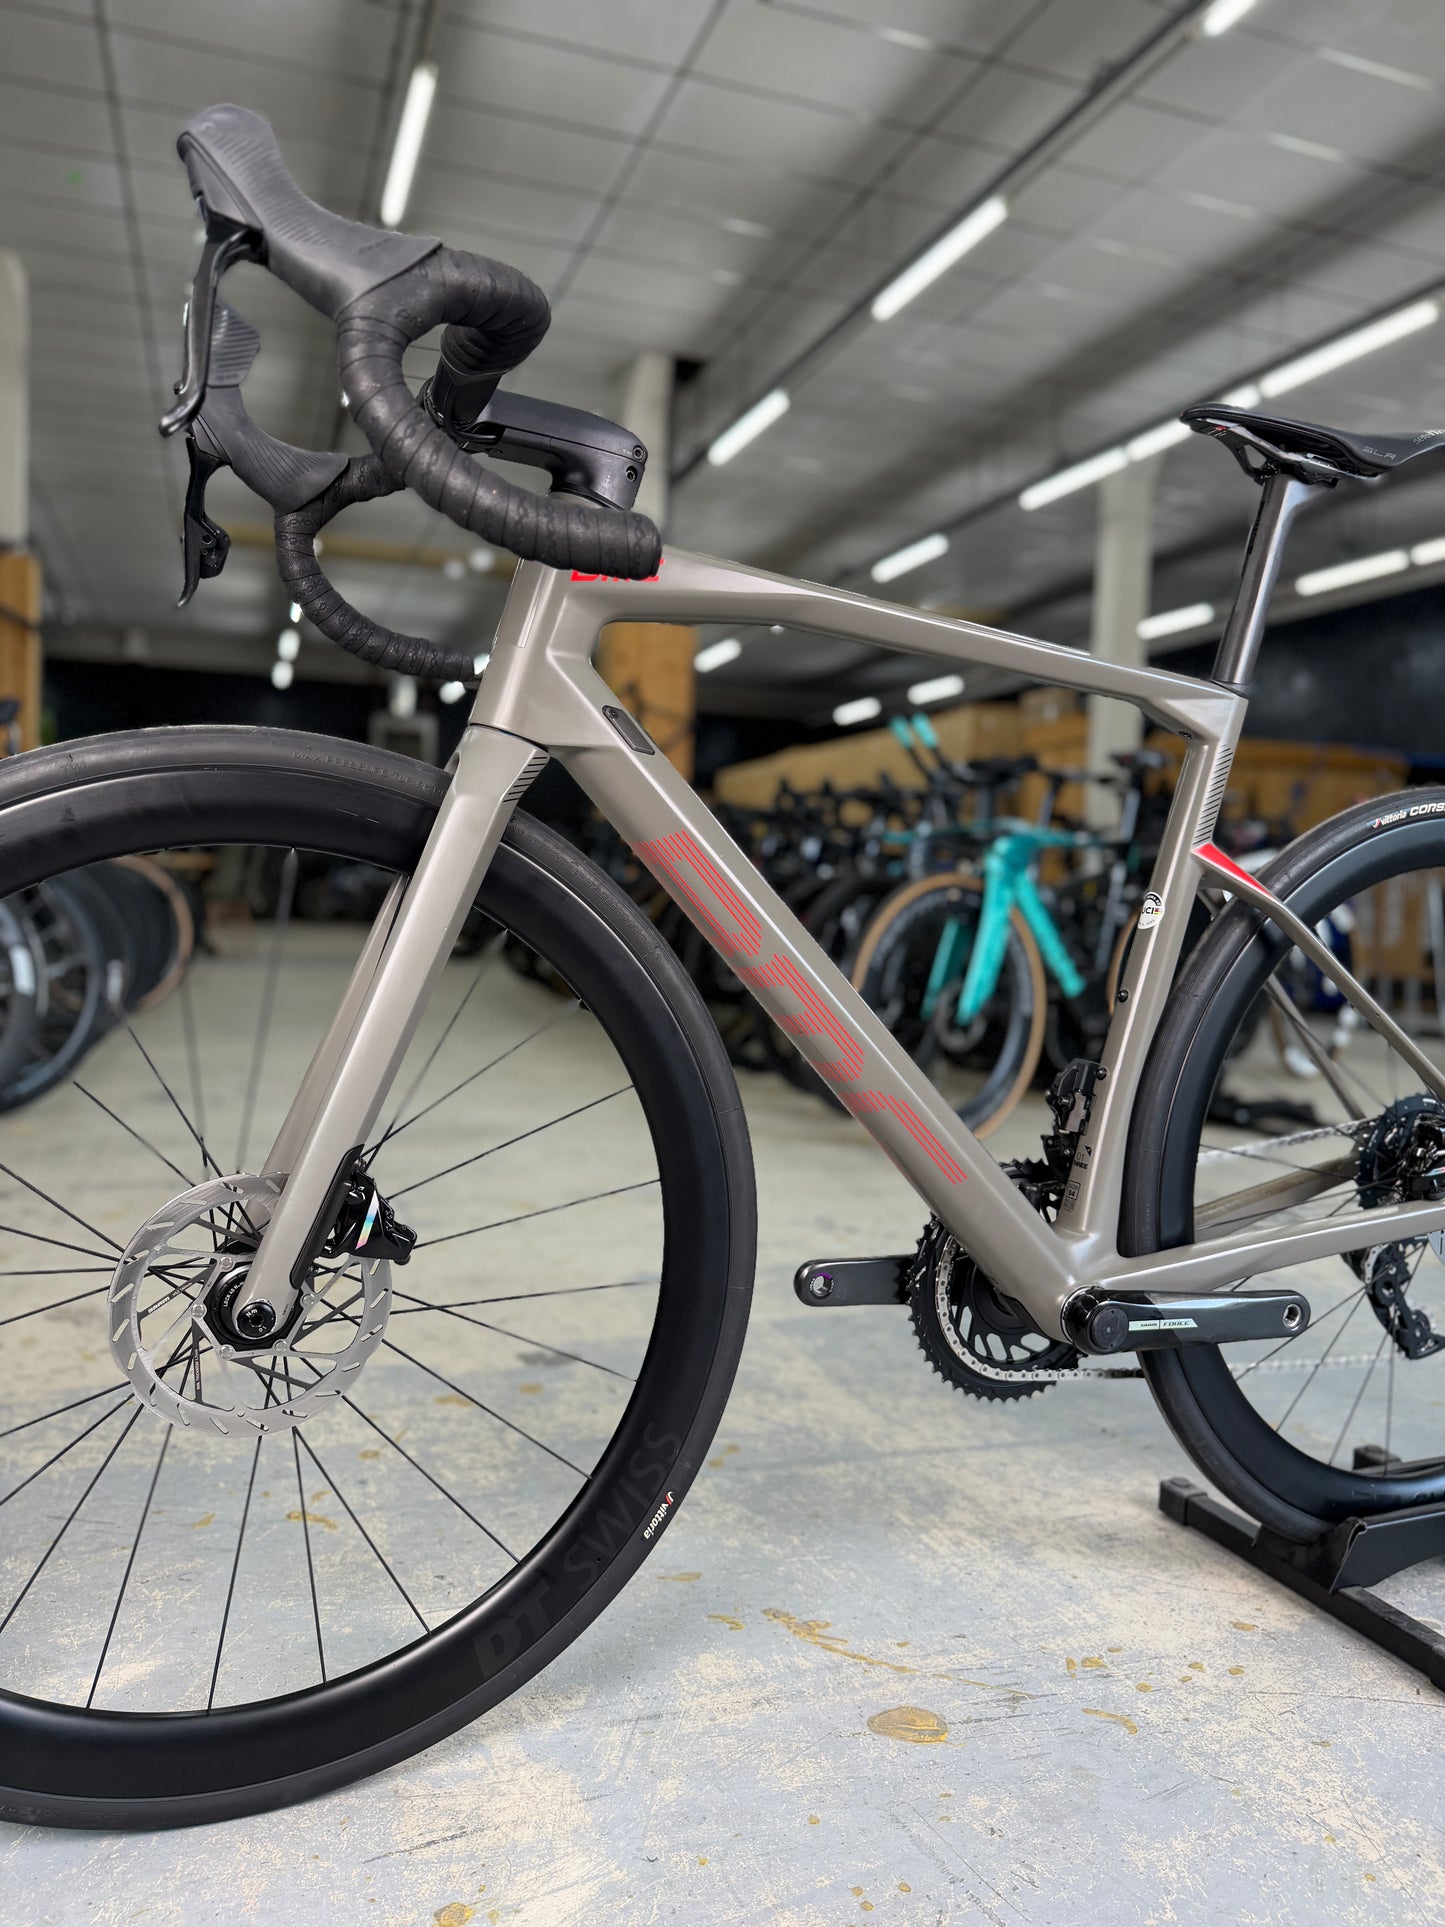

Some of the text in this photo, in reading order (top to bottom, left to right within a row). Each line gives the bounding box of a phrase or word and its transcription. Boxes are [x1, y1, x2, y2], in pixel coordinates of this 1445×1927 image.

[1362, 446, 1397, 460] SLR
[1379, 802, 1445, 826] vittoria CORS
[147, 1296, 171, 1314] SRAM
[643, 1502, 670, 1540] vittoria
[471, 1422, 682, 1682] DT SWISS
